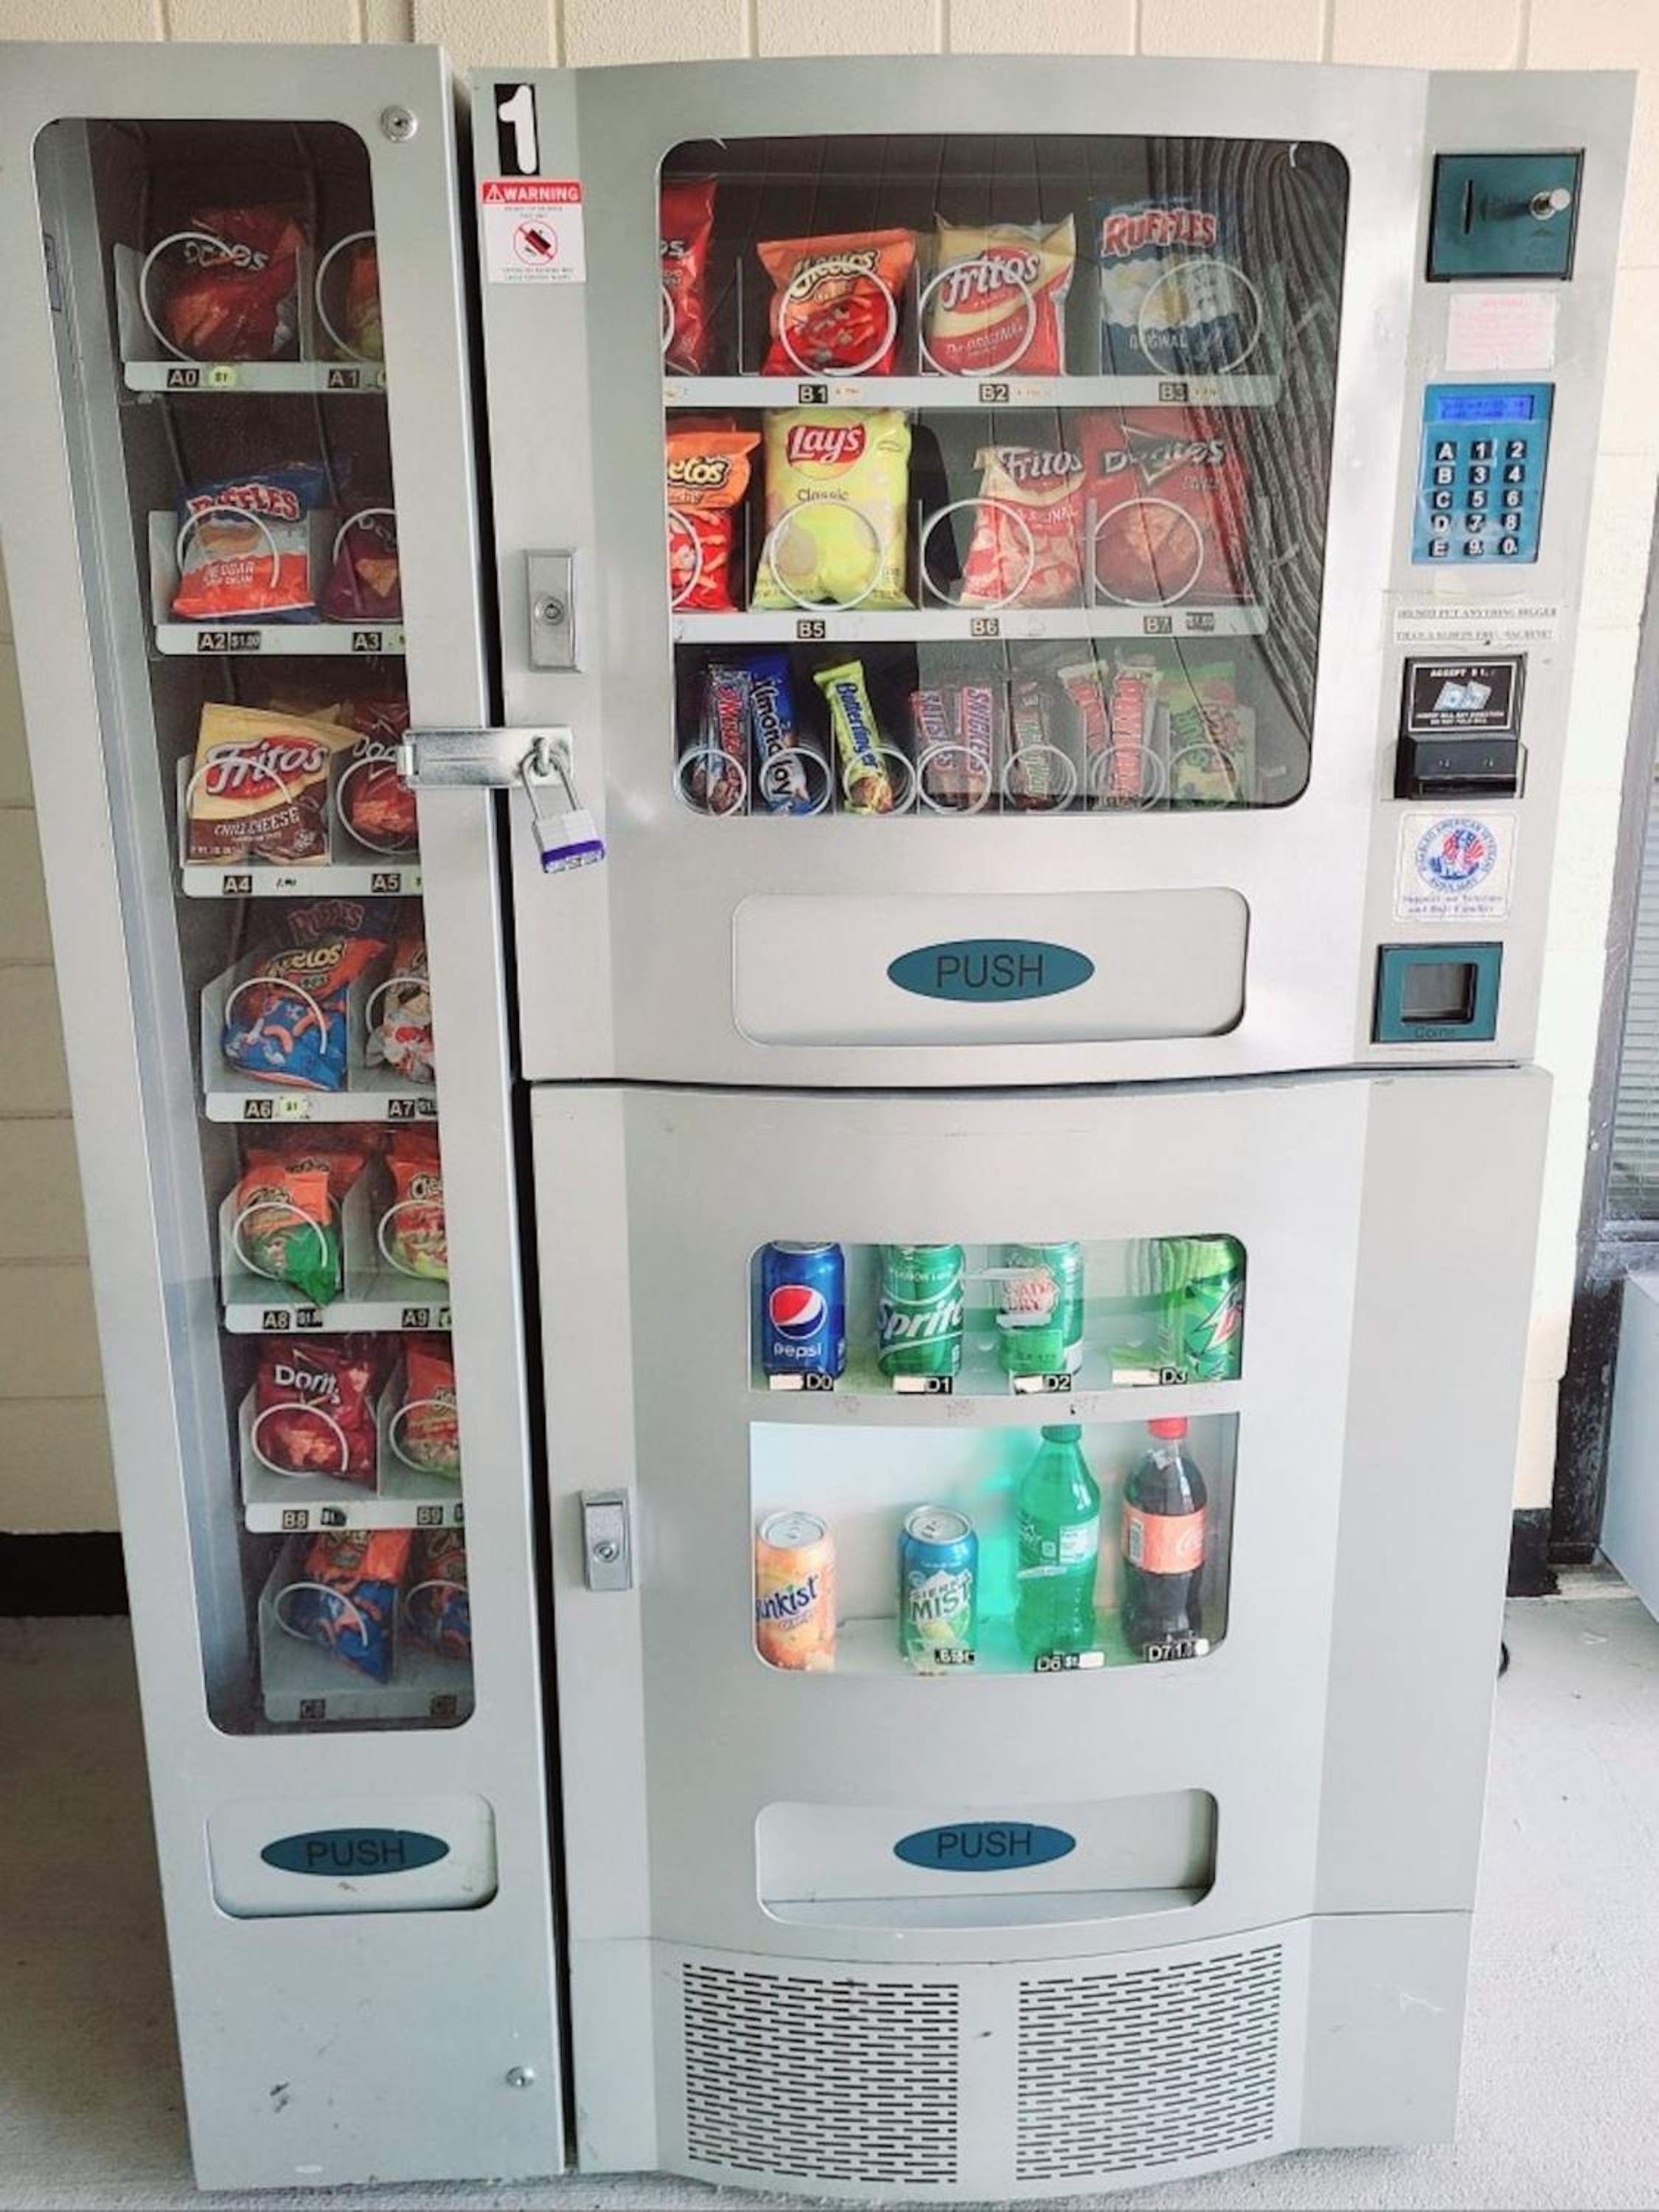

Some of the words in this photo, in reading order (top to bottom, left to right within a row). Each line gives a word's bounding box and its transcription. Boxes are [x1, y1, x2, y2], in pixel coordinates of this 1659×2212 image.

[499, 85, 537, 174] 1
[503, 186, 579, 201] WARNING
[1102, 209, 1217, 257] RUFFLES
[939, 252, 1040, 311] Fritos
[170, 370, 198, 387] A0
[332, 371, 358, 388] A1
[800, 386, 827, 403] B1
[981, 385, 1008, 401] B2
[1160, 384, 1186, 401] B3
[1439, 444, 1453, 460] A
[1475, 444, 1485, 459] 1
[1511, 442, 1523, 458] 2
[1004, 451, 1083, 479] Fritos
[1439, 467, 1453, 484] B
[1474, 466, 1486, 482] 3
[1508, 466, 1520, 481] 4
[798, 490, 849, 501] Classic
[1436, 492, 1450, 508] C
[1471, 492, 1484, 507] 5
[1506, 491, 1519, 507] 6
[1435, 517, 1448, 532] D
[1470, 515, 1483, 530] 7
[1506, 515, 1517, 531] 8
[1433, 540, 1446, 556] E
[799, 621, 825, 637] B5
[972, 619, 998, 635] B6
[199, 634, 226, 650] A2
[354, 634, 380, 650] A3
[1430, 669, 1466, 677] ACCEPT
[966, 687, 992, 772] SNICKERS
[206, 737, 327, 793] Fritos
[225, 878, 250, 893] A4
[372, 875, 400, 892] A5
[936, 956, 1044, 989] PUSH
[246, 1103, 271, 1117] A6
[390, 1103, 414, 1117] A7
[265, 1312, 288, 1328] A8
[404, 1312, 426, 1326] A9
[774, 1344, 822, 1360] pepsi
[806, 1374, 832, 1389] D0
[1047, 1375, 1070, 1390] D2
[1163, 1369, 1186, 1384] D3
[275, 1365, 341, 1405] Dorits
[927, 1379, 951, 1393] D1
[283, 1512, 307, 1528] B8
[418, 1509, 441, 1524] B9
[912, 1583, 967, 1621] MIST
[1149, 1645, 1169, 1660] D7
[1037, 1656, 1061, 1671] D6
[937, 1829, 1032, 1859] PUSH
[305, 1840, 406, 1867] PUSH
